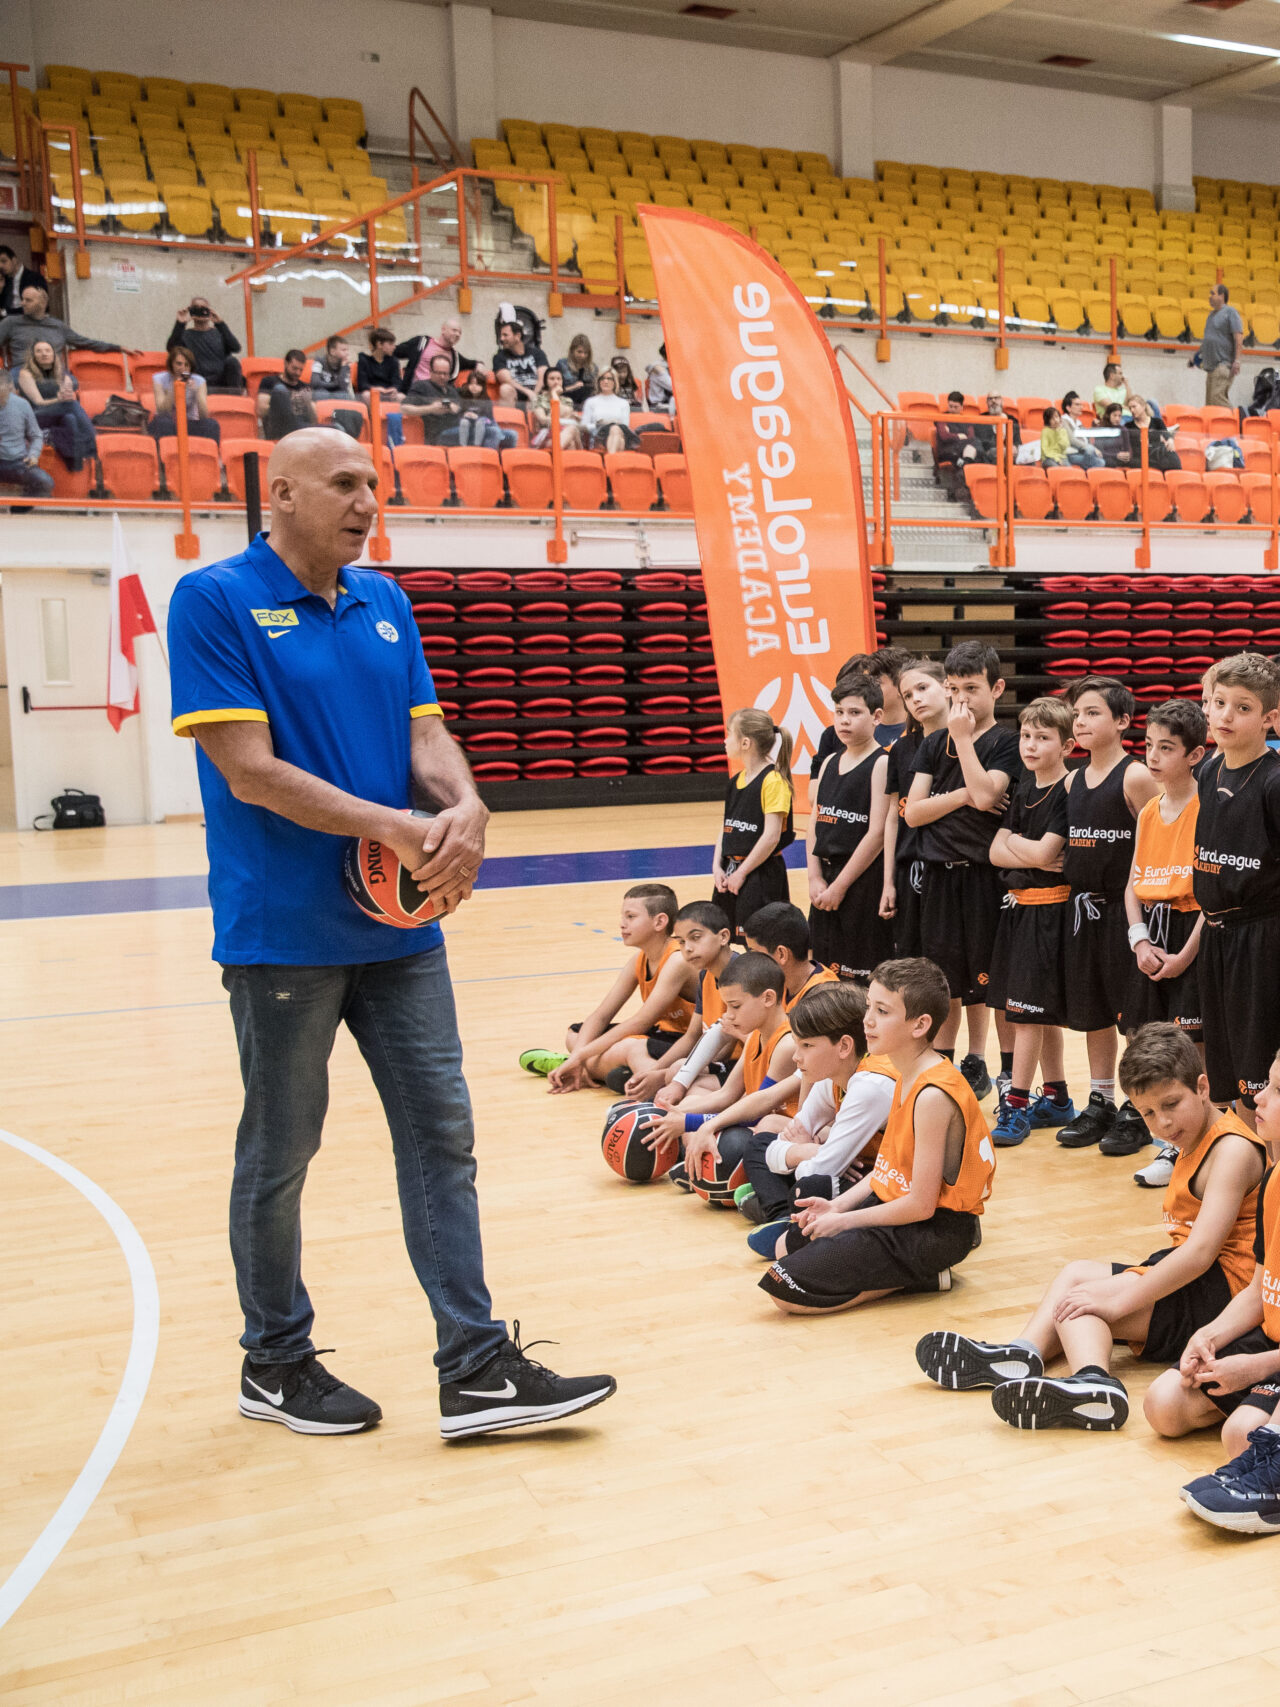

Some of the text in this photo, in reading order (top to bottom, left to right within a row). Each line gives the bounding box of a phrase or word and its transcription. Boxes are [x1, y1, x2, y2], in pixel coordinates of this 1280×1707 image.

[256, 612, 294, 624] FOX
[1069, 826, 1132, 842] EuroLeague
[368, 840, 387, 884] DING
